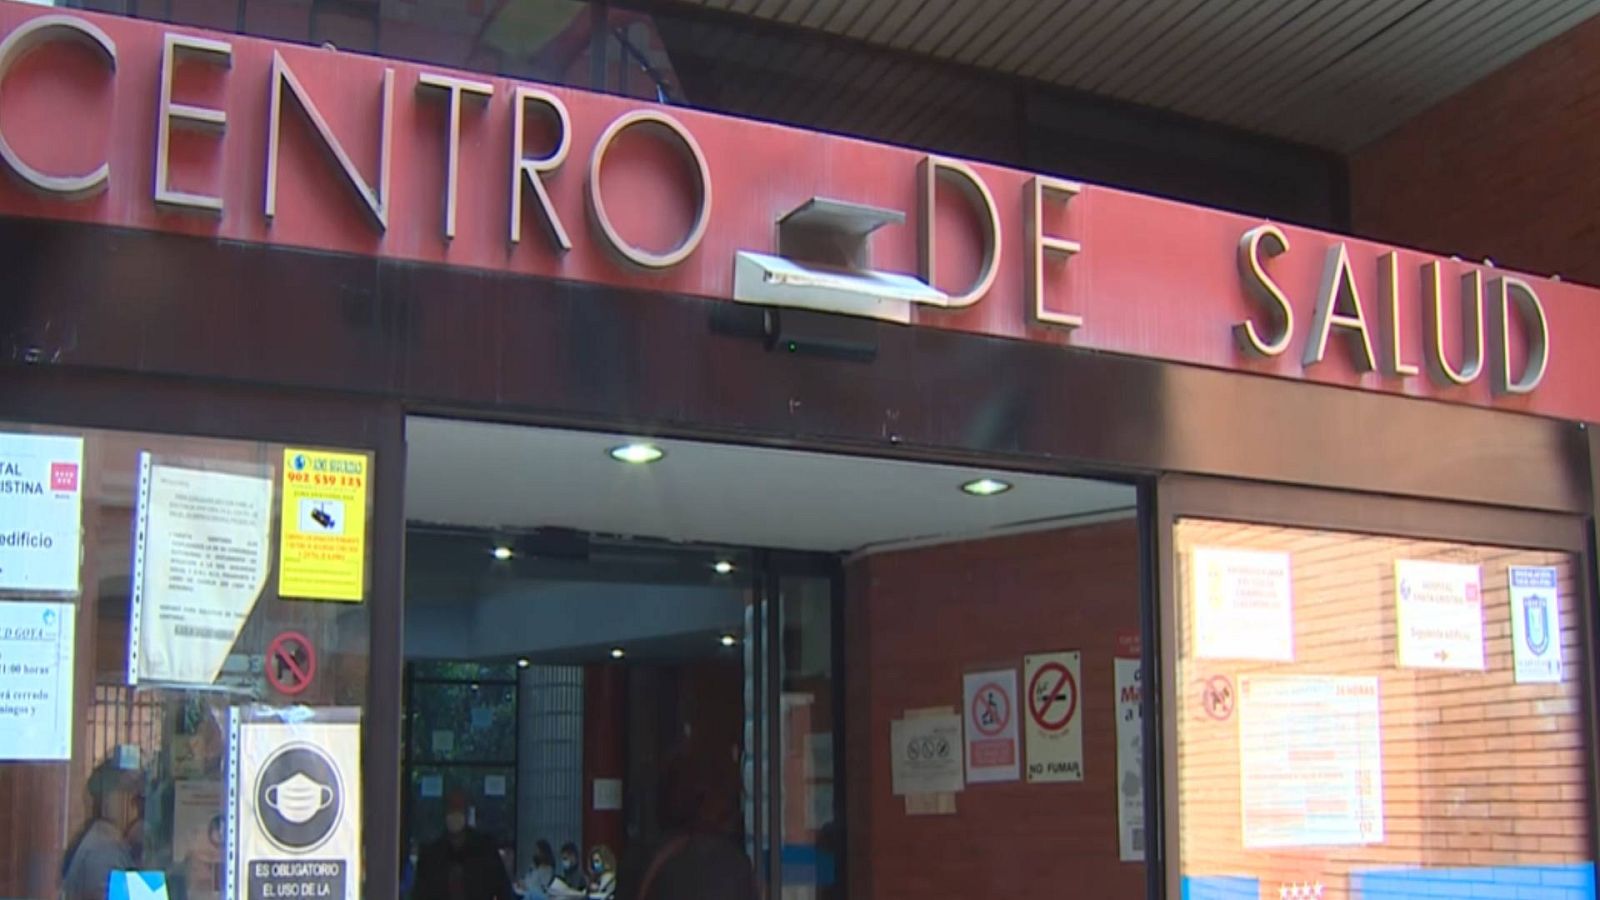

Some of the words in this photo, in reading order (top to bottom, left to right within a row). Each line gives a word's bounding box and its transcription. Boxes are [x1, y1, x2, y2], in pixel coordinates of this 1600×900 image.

[0, 14, 712, 268] CENTRO
[917, 156, 1082, 330] DE
[1232, 223, 1550, 394] SALUD
[1029, 762, 1044, 775] NO
[1047, 760, 1080, 774] FUMAR
[256, 863, 270, 878] ES
[272, 862, 340, 878] OBLIGATORIO
[263, 882, 276, 898] EL
[277, 882, 300, 898] USO
[301, 882, 315, 897] DE
[317, 882, 331, 898] LA
